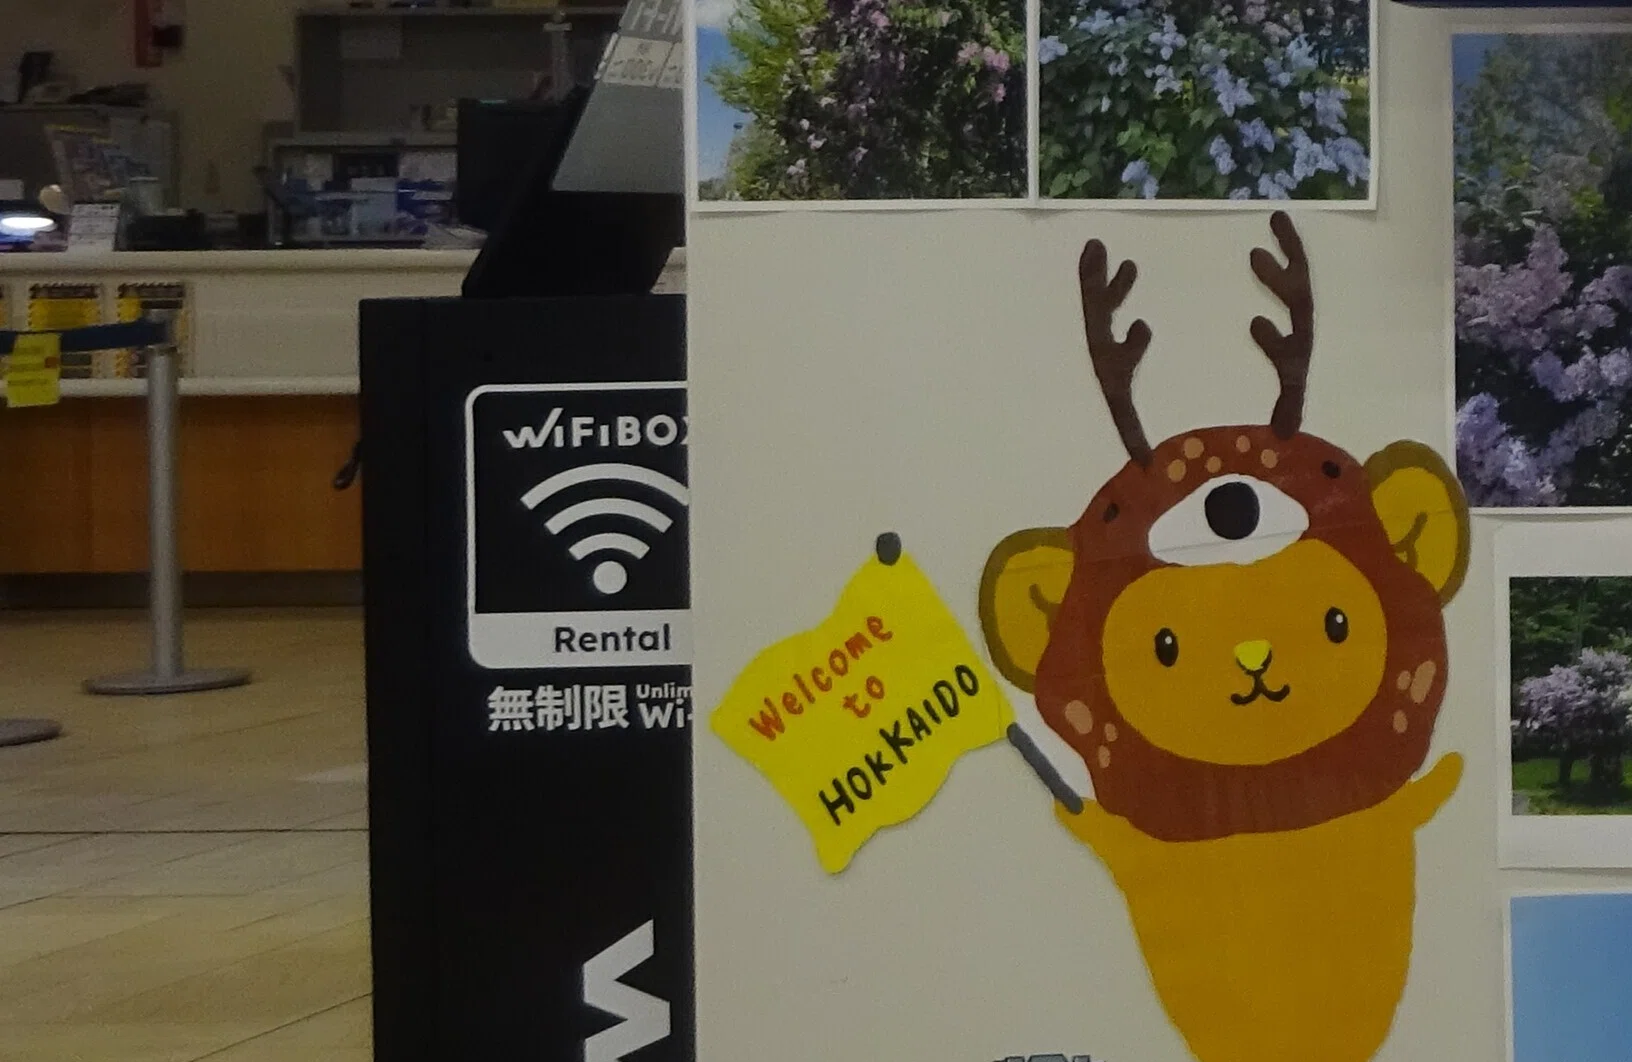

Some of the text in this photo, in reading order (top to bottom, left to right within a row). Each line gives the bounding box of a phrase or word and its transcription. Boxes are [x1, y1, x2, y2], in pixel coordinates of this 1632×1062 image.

[555, 624, 671, 652] Rental
[749, 616, 893, 741] Welcome
[843, 676, 885, 718] to
[488, 684, 629, 732] 無制限
[818, 664, 980, 826] HOKKAIDO
